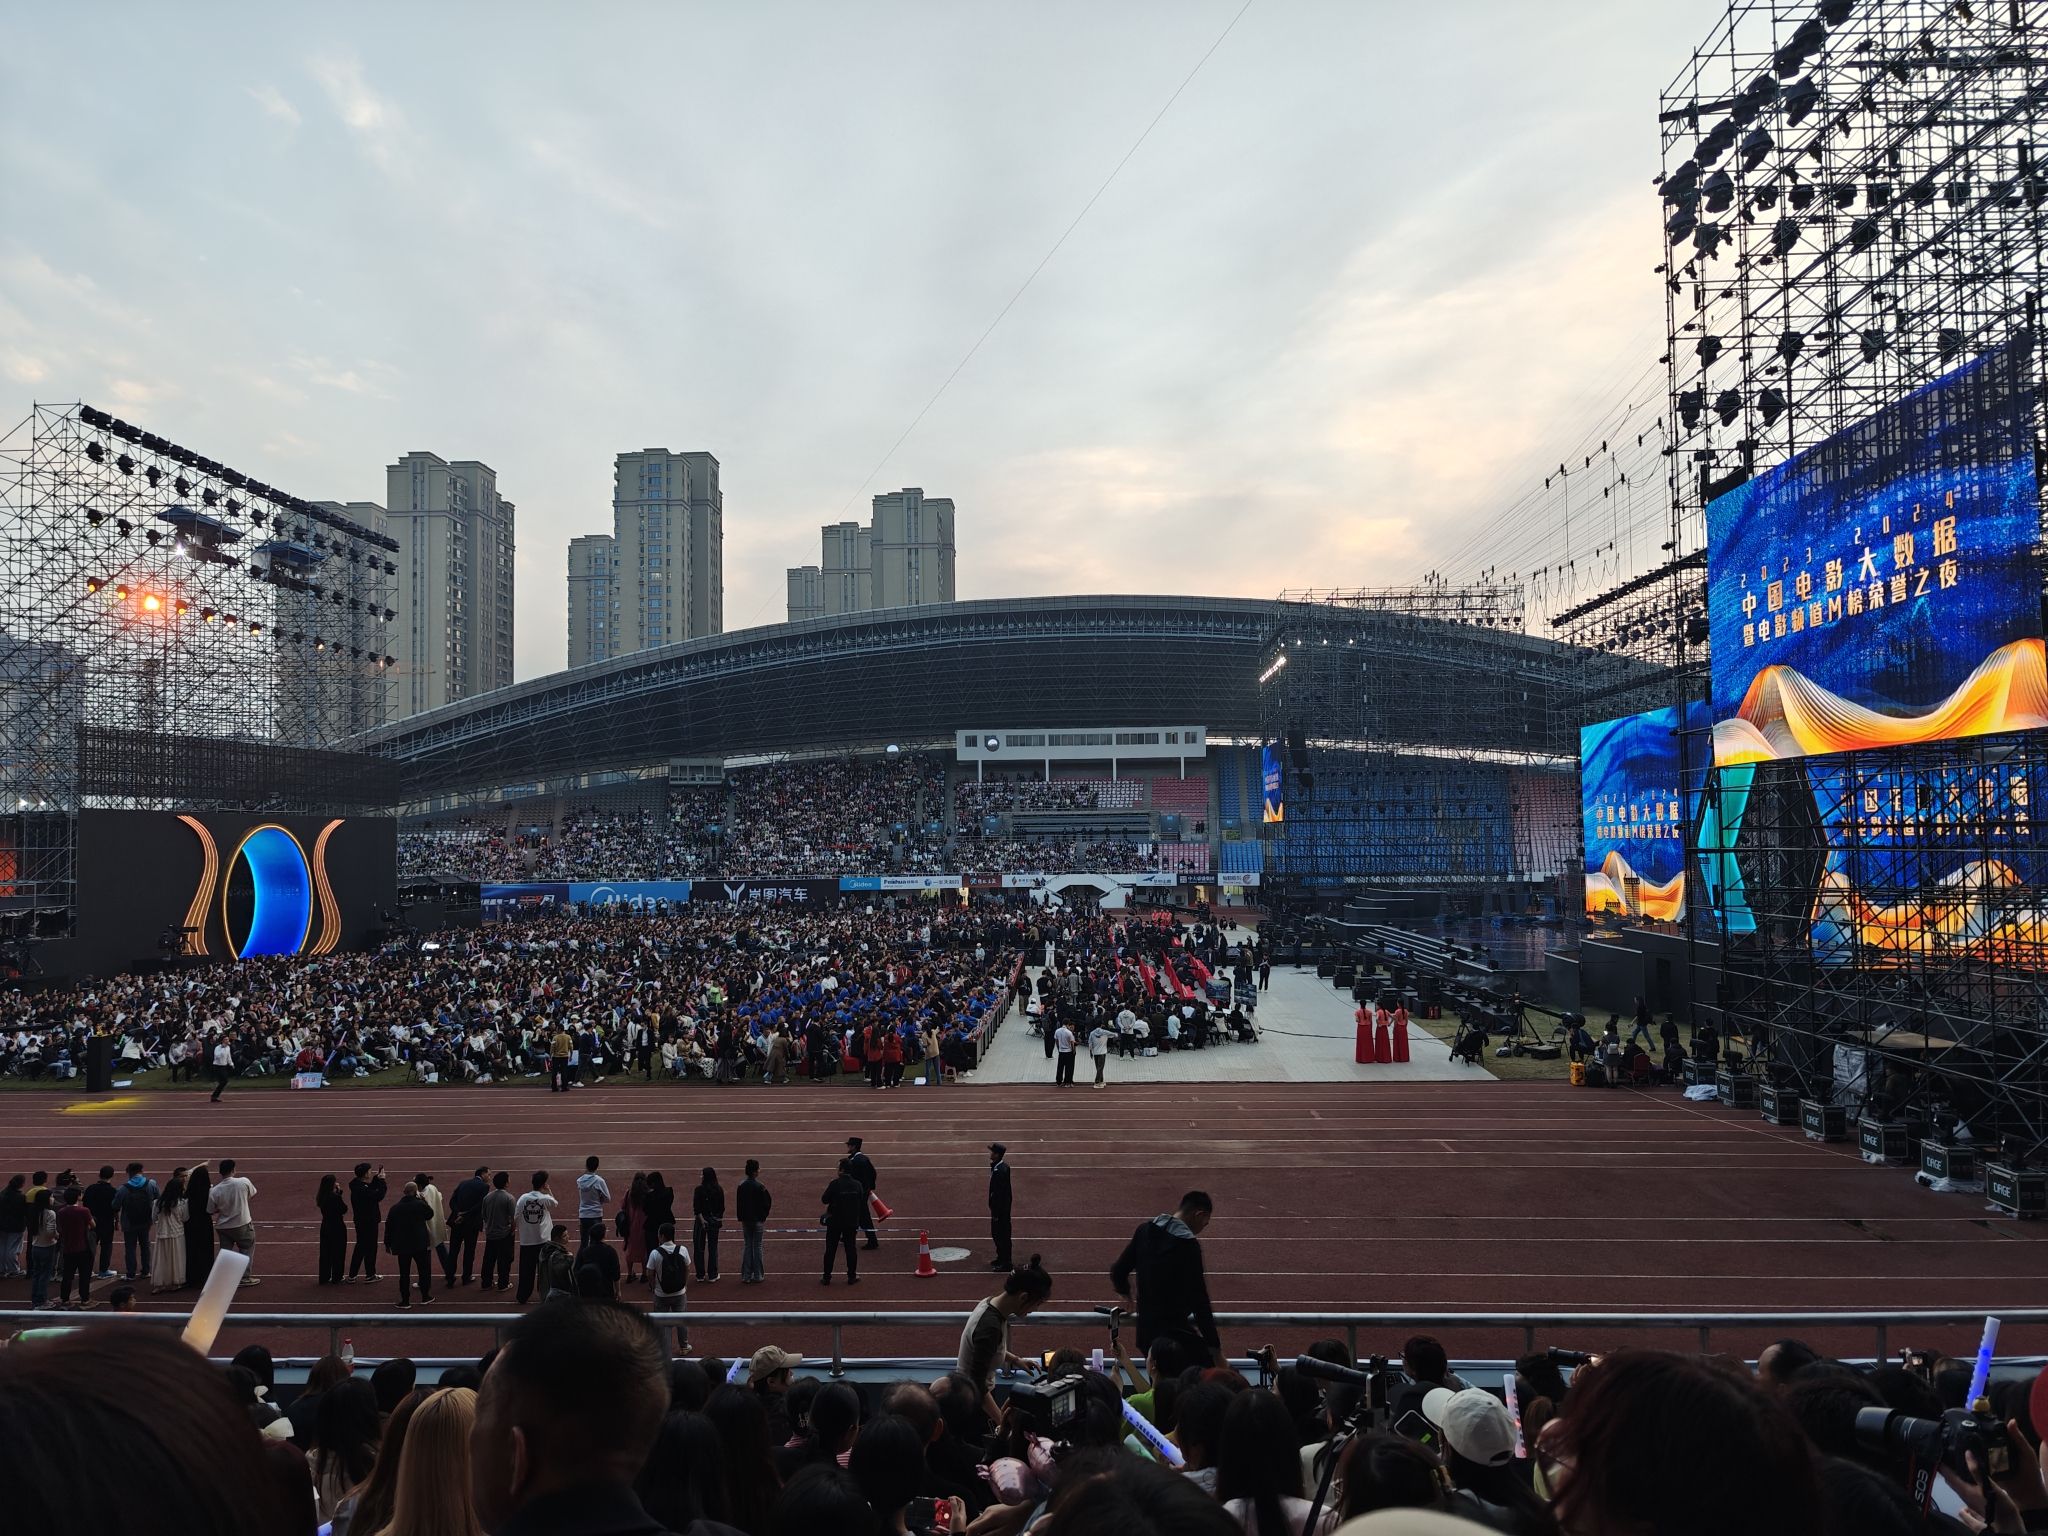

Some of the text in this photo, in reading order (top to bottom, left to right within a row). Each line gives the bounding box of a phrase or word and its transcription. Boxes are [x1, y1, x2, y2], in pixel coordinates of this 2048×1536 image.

[1742, 515, 1957, 619] 中国电影大数据
[1743, 559, 1958, 648] 暨电影频道M榜荣誉之夜
[1596, 801, 1679, 823] 中国电影大数据
[749, 887, 808, 903] 岚图汽车
[1914, 1469, 1929, 1503] EOS
